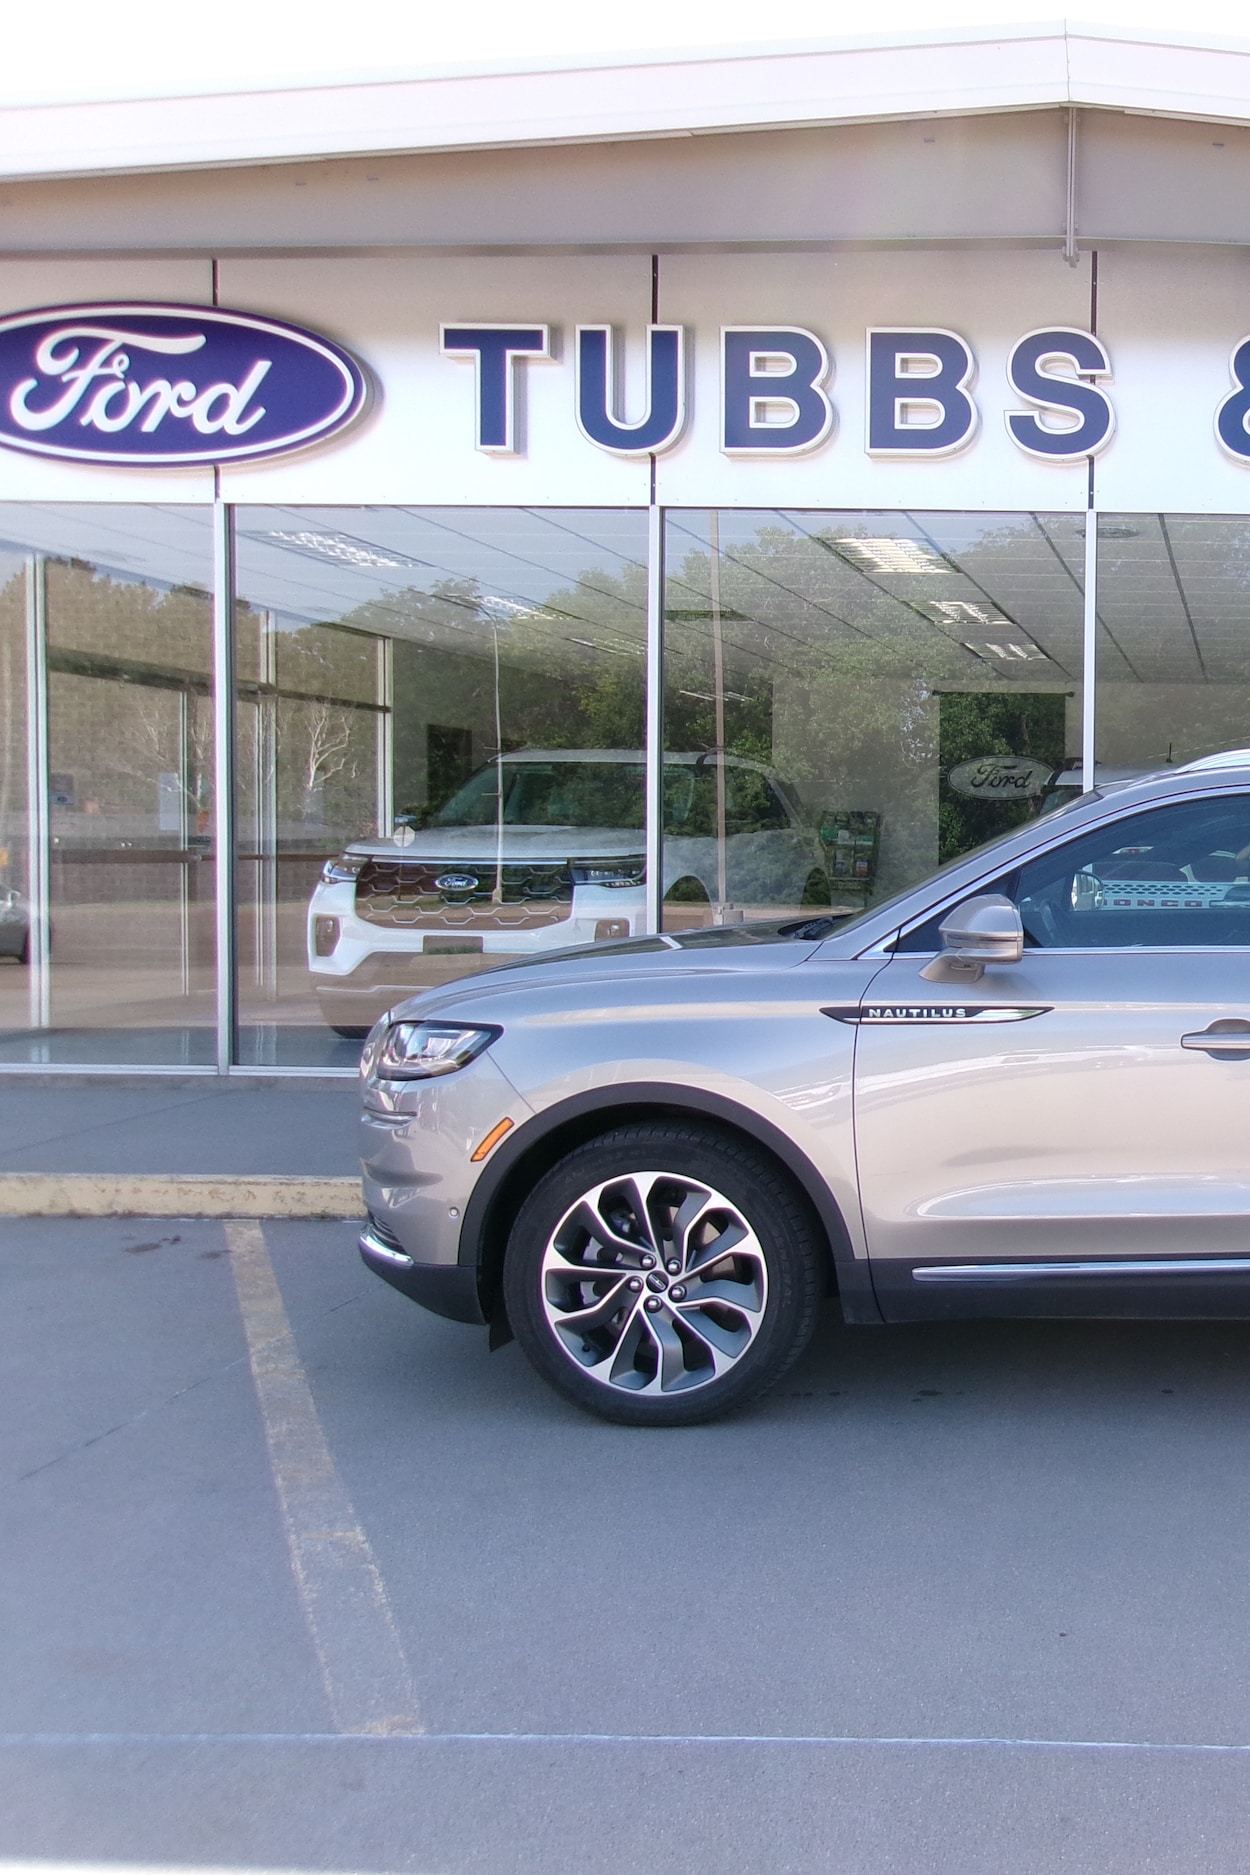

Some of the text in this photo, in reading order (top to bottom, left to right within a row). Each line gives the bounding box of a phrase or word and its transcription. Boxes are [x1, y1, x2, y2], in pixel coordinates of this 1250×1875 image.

[11, 326, 273, 435] Ford
[439, 323, 1115, 461] TUBBS
[971, 763, 1033, 789] Ford
[444, 876, 469, 888] Ford
[1103, 898, 1203, 908] ONCO
[868, 1007, 967, 1018] NAUTILUS
